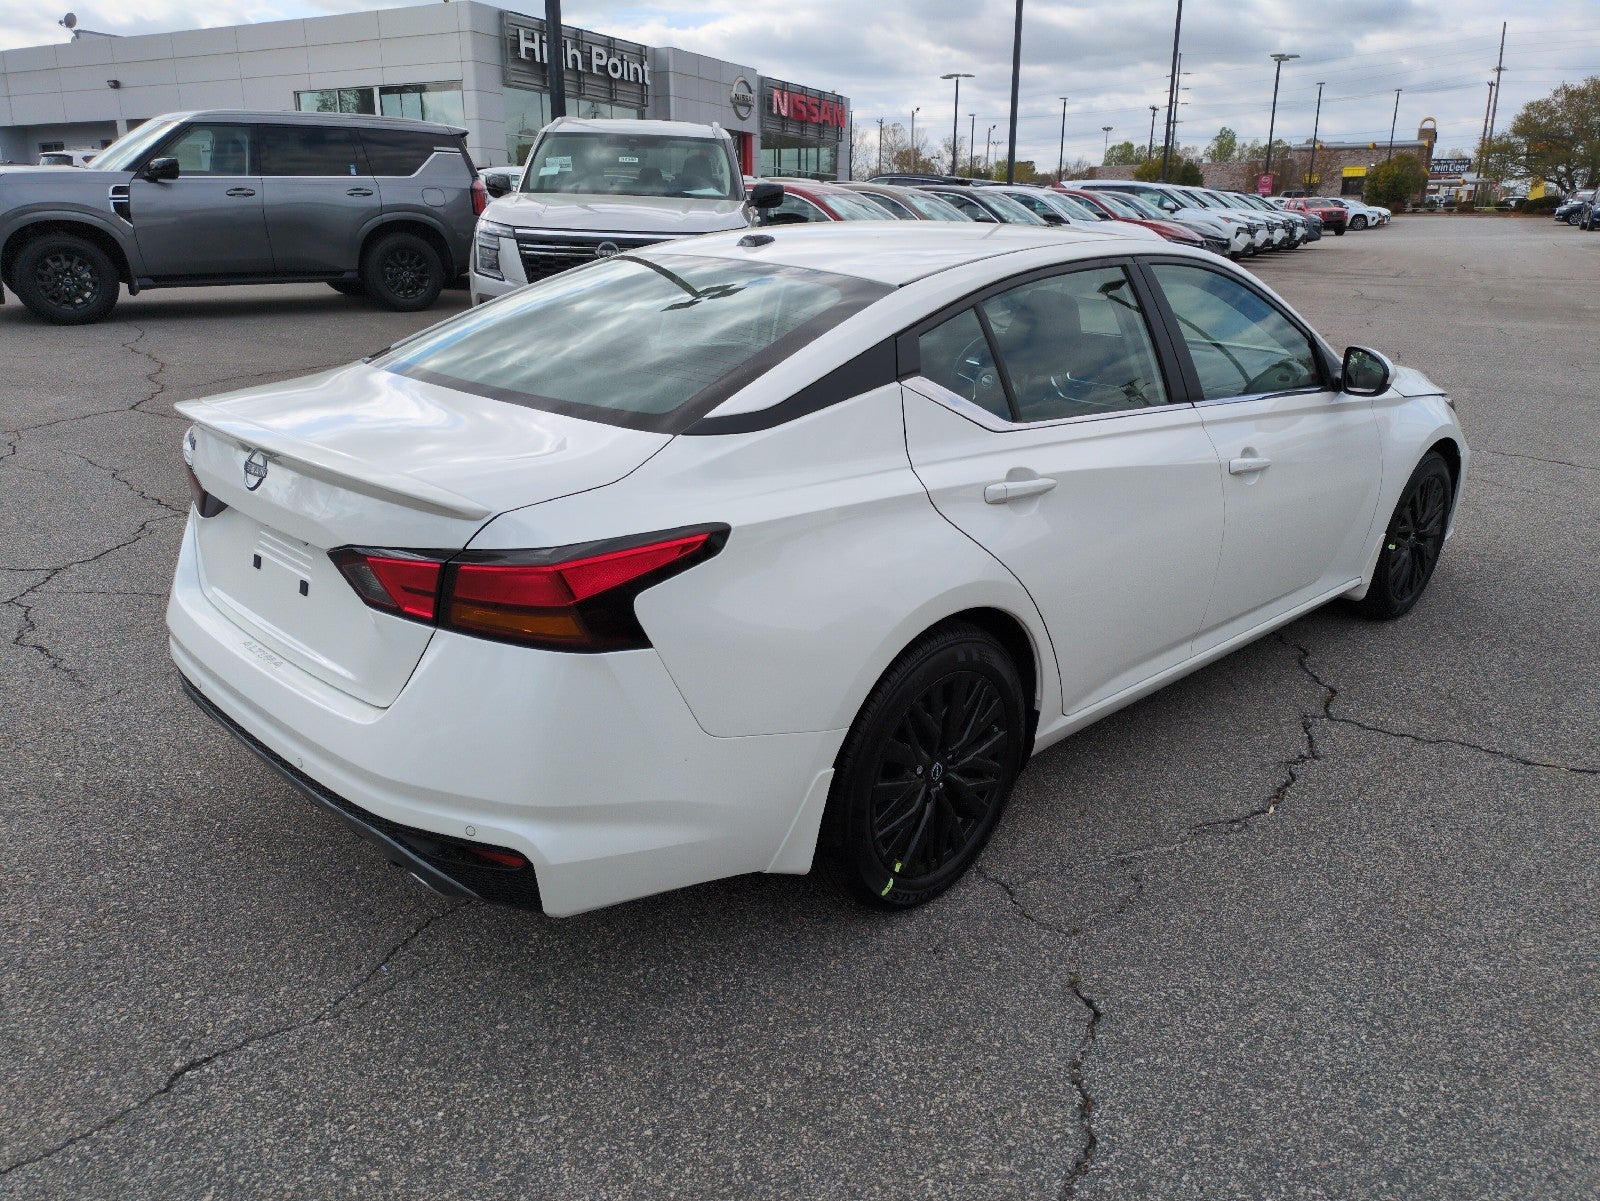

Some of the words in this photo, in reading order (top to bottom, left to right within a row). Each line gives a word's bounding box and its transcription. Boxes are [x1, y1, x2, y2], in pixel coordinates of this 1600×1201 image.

[517, 28, 582, 71] Hih
[590, 45, 650, 86] Point
[772, 87, 846, 128] NISSAN
